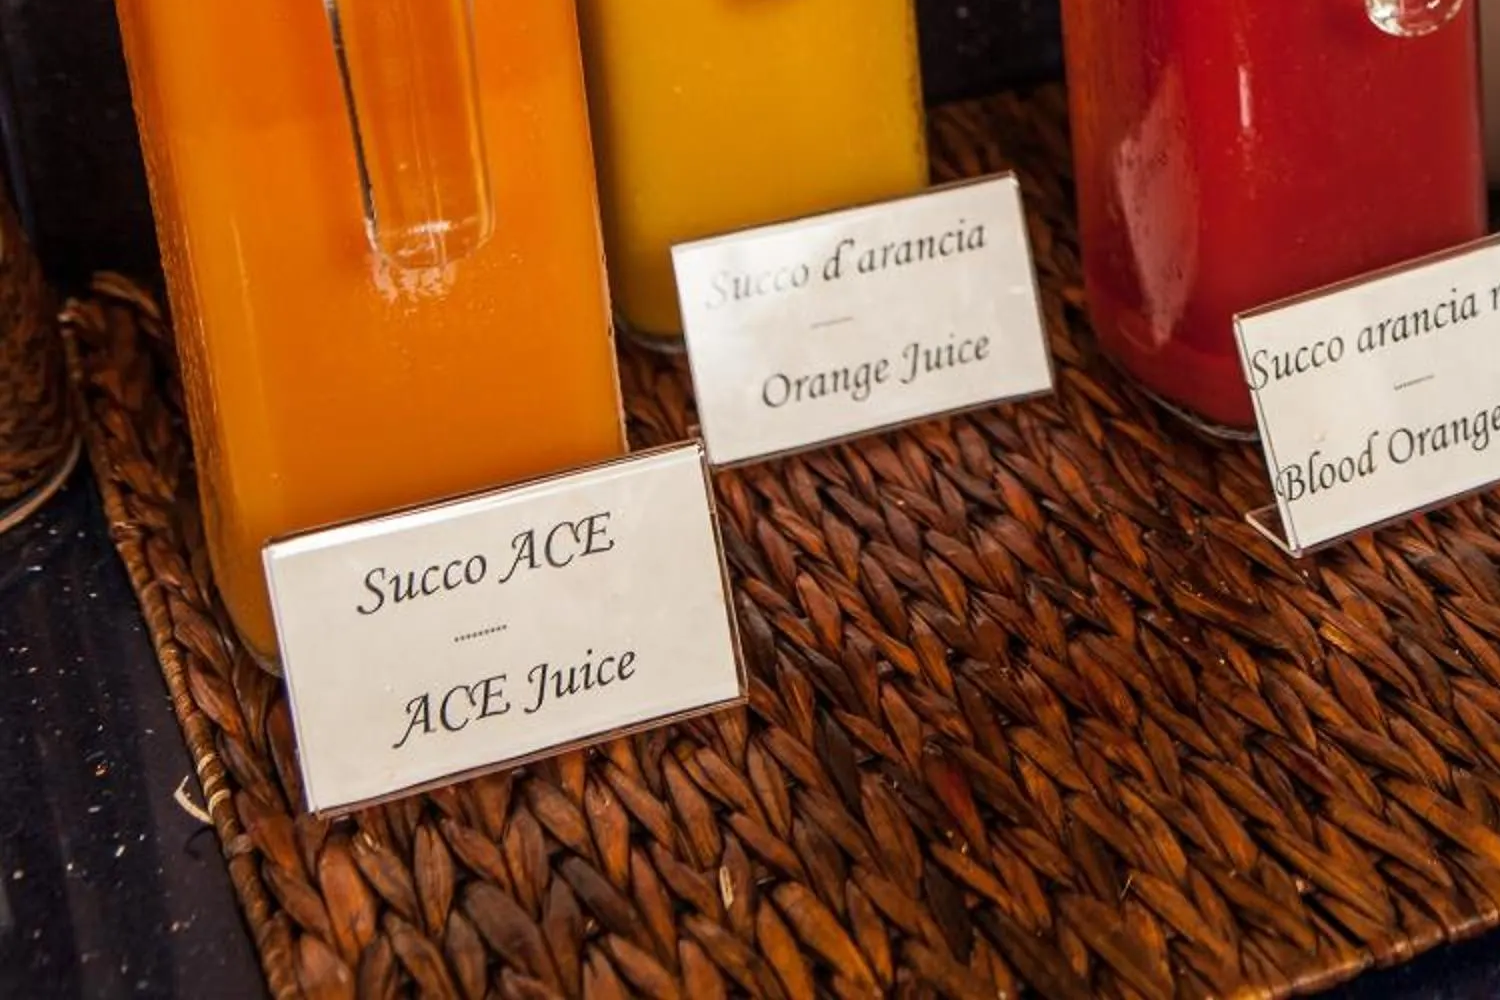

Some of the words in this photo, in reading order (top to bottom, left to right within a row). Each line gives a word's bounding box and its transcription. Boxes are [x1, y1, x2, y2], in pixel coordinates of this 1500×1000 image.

[705, 262, 810, 312] Succo
[821, 217, 988, 283] d'arancia
[761, 357, 890, 409] Orange
[901, 332, 991, 386] Juice
[1248, 335, 1346, 392] Succo
[1356, 287, 1482, 354] arancia
[1275, 430, 1380, 502] Blood
[355, 552, 488, 616] Succo
[498, 511, 615, 585] ACE
[391, 673, 512, 750] ACE
[523, 648, 637, 715] Juice
